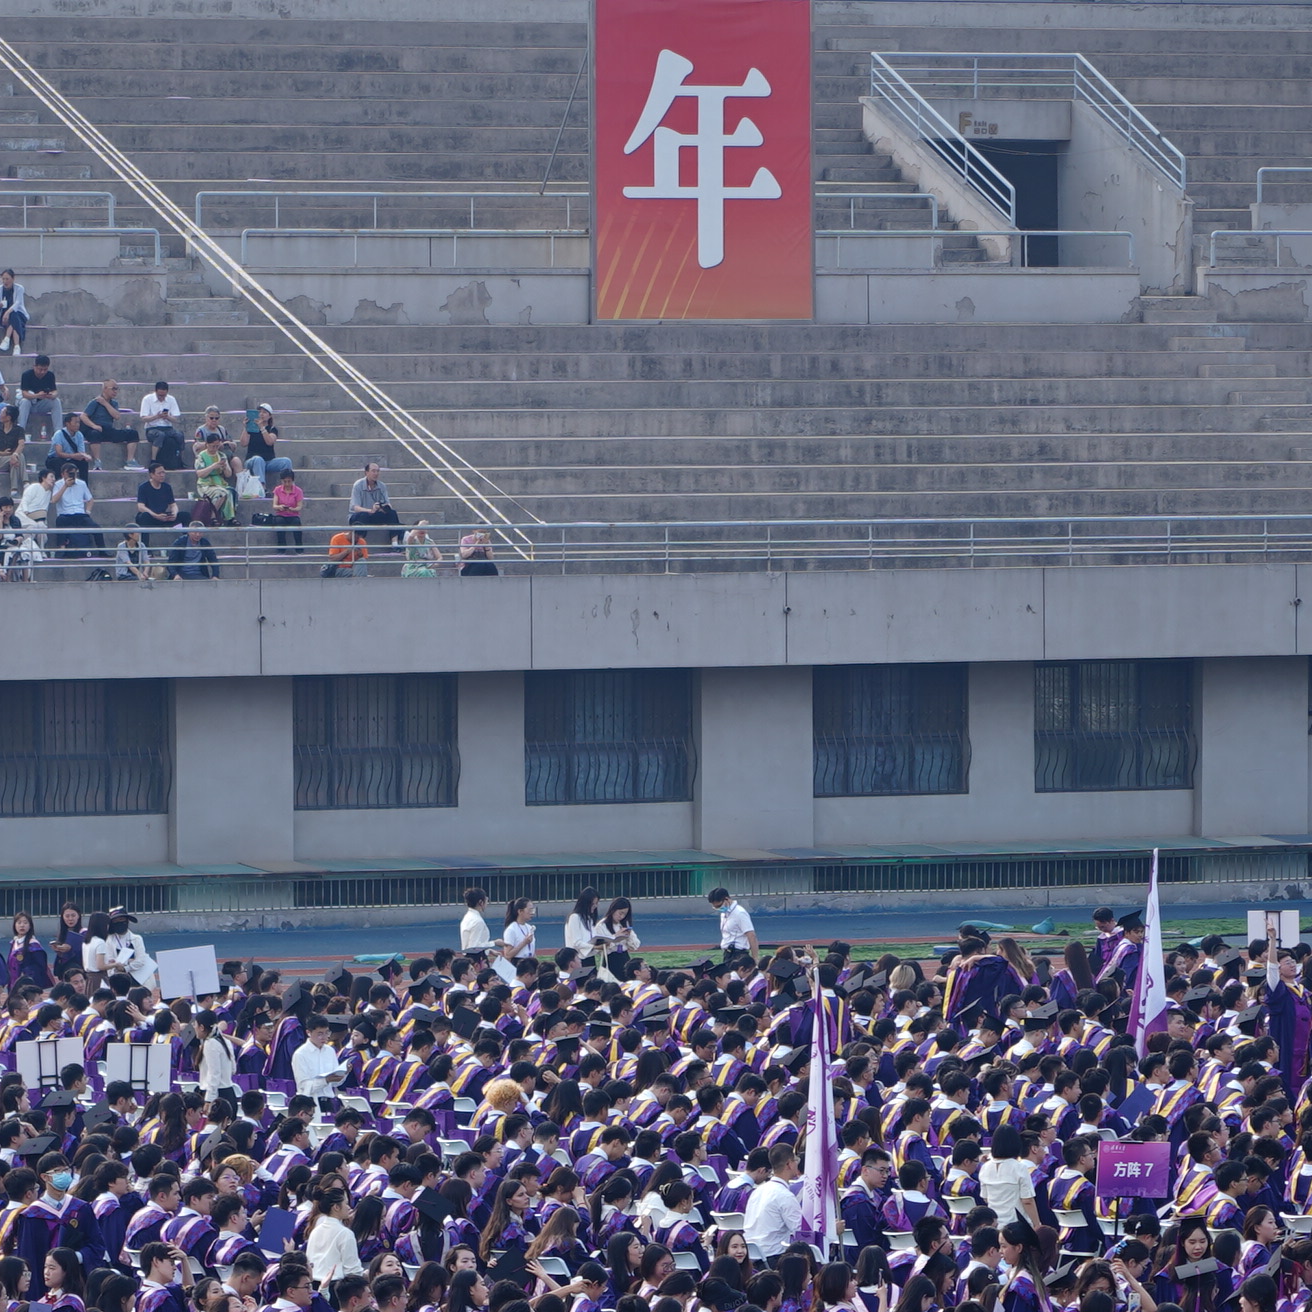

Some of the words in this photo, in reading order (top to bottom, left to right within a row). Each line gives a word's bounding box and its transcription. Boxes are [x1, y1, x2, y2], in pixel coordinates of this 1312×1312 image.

[623, 48, 783, 269] 年
[1113, 1161, 1142, 1178] 方阵
[1144, 1162, 1154, 1178] 7
